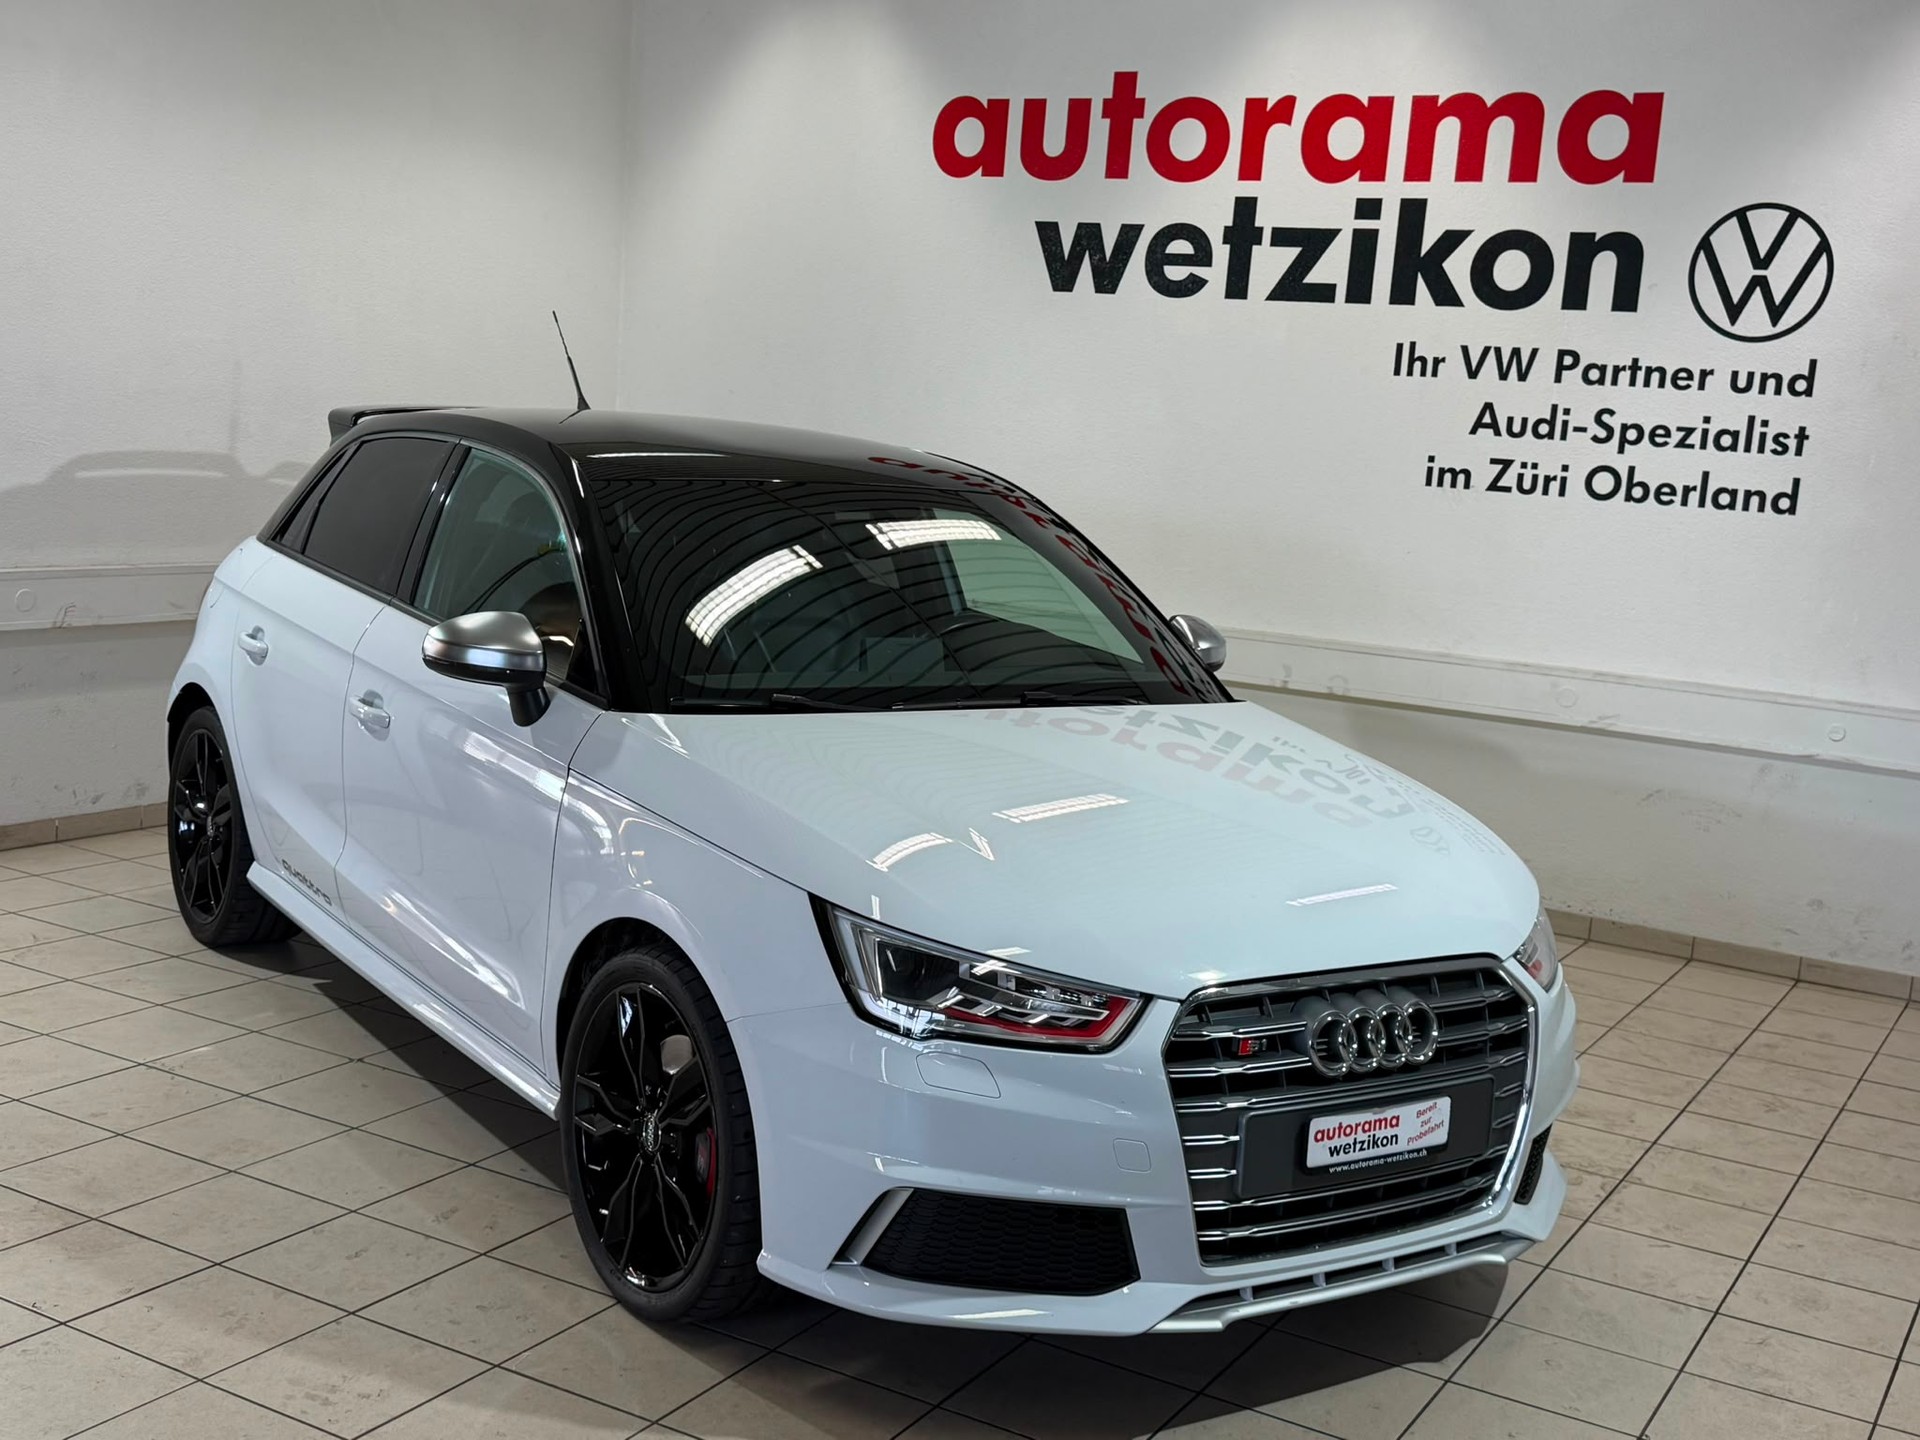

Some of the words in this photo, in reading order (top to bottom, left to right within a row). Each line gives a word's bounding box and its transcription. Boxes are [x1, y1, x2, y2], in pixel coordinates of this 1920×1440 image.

[933, 72, 1665, 185] autorama
[1035, 197, 1645, 313] wetzikon
[1394, 341, 1446, 378] Ihr
[1461, 345, 1540, 383] VW
[1553, 349, 1715, 391] Partner
[1730, 359, 1818, 398] und
[1469, 402, 1810, 457] Audi-Spezialist
[1424, 456, 1472, 490] im
[1486, 458, 1570, 498] Züri
[1584, 465, 1801, 516] Oberland
[1416, 1102, 1437, 1119] Bereit
[1420, 1116, 1433, 1128] zur
[1314, 1114, 1400, 1143] autorama
[1407, 1119, 1445, 1146] Probefahrt
[1328, 1133, 1399, 1158] wetzikon
[1329, 1149, 1428, 1174] www.autorama-wetzikon.ch
